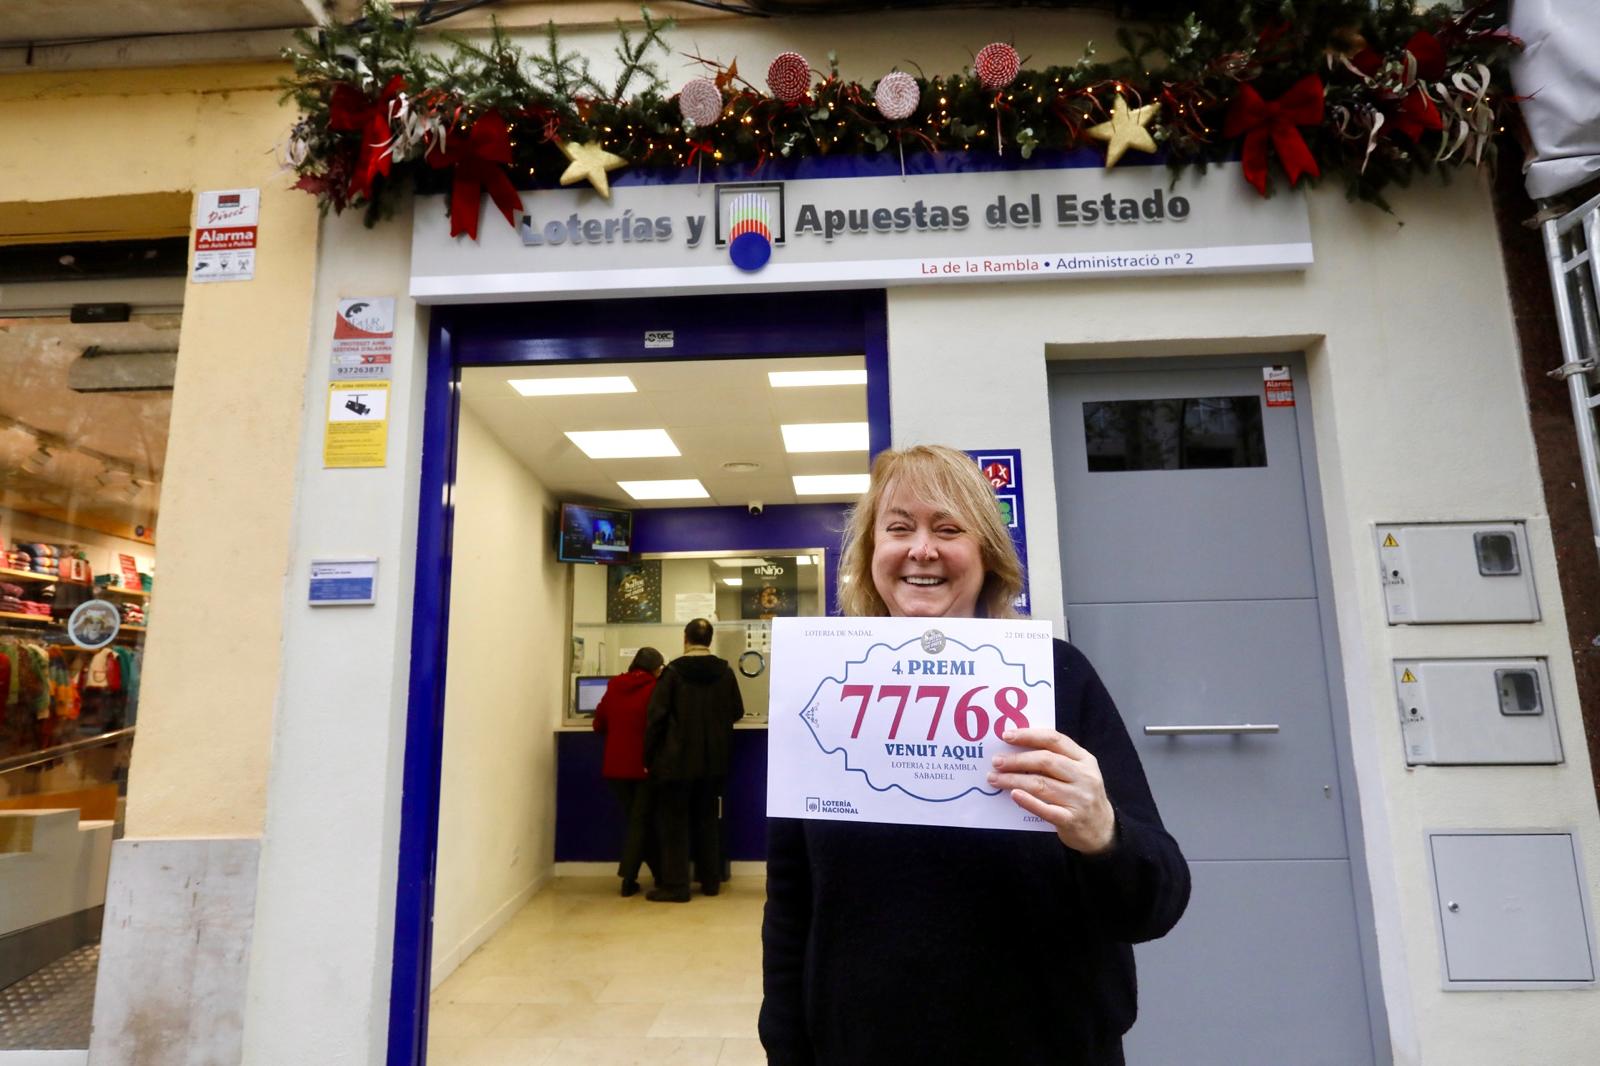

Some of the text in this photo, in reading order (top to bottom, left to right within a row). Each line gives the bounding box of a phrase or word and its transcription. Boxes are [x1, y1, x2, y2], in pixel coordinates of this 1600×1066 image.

[208, 205, 249, 224] Direct
[794, 188, 1190, 242] Apuestas del Estado
[199, 229, 254, 243] Alarma
[522, 209, 706, 248] Loterías y
[921, 252, 1194, 274] La de la Rambla Administració nº 2
[908, 660, 975, 676] PREMI
[840, 685, 1030, 742] 77768
[885, 743, 984, 760] VENUT AQUÍ
[891, 761, 977, 771] LOTERIA 2 LA RAMBLA
[914, 772, 954, 781] SABADELL
